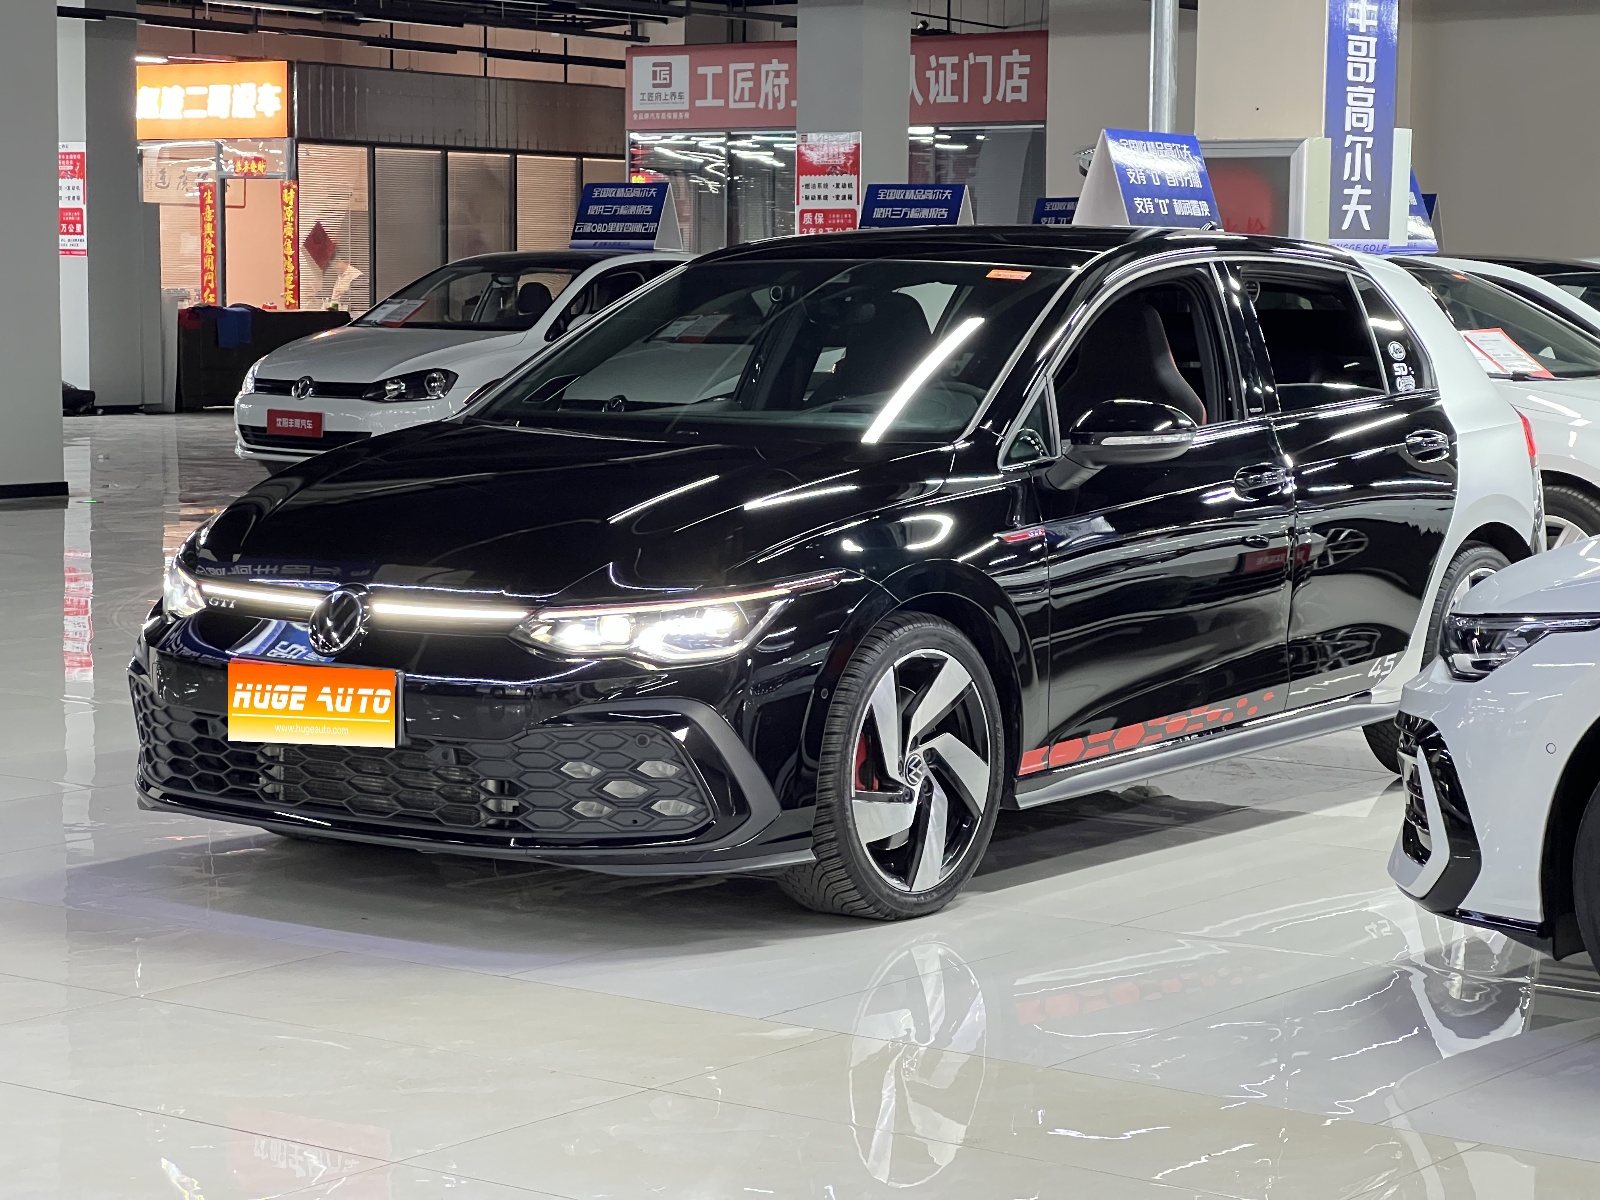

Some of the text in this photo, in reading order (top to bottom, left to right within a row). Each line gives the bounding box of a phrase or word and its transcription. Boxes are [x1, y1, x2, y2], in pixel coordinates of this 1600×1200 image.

[695, 58, 797, 111] 工匠府
[639, 91, 685, 102] 工匠府上养车
[802, 212, 825, 225] 质保
[208, 597, 237, 609] GTI
